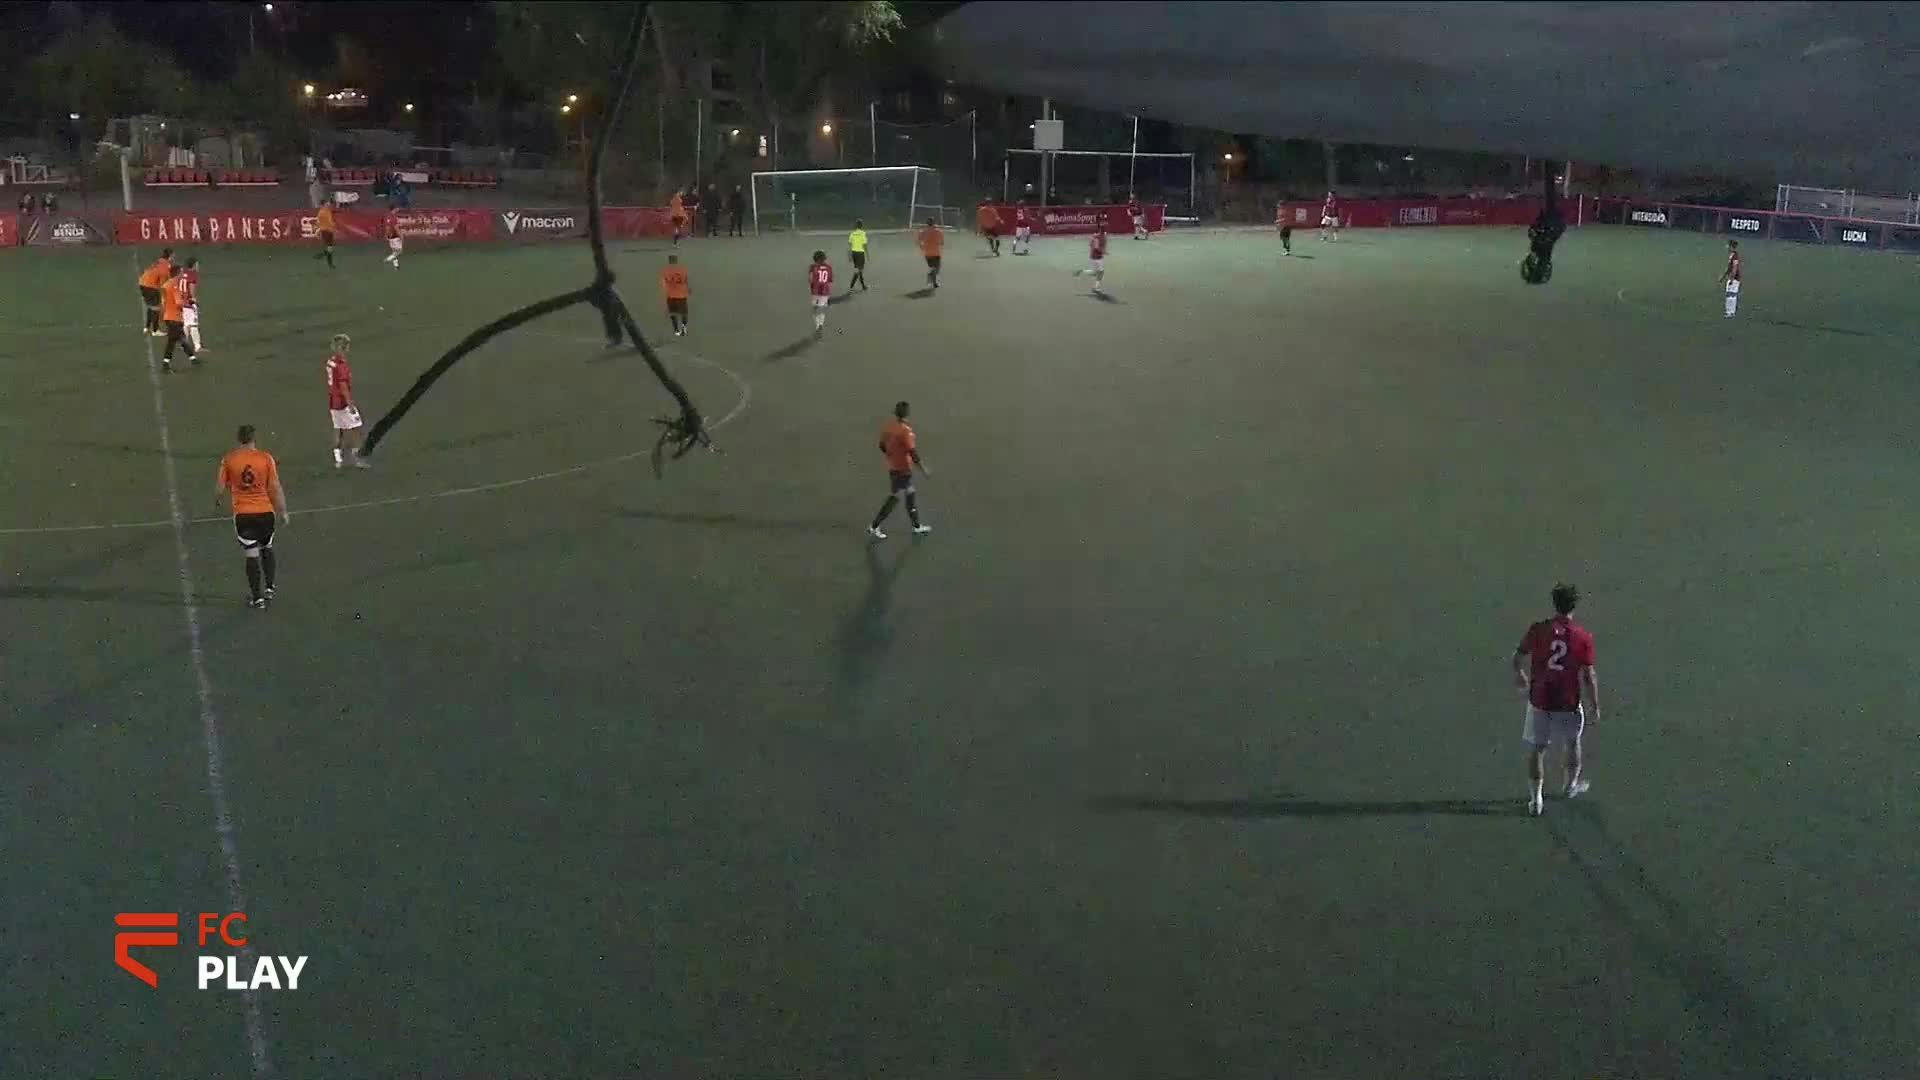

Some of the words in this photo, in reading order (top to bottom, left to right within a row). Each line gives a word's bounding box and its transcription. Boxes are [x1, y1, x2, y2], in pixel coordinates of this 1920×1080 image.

[522, 216, 575, 229] macron
[1731, 218, 1760, 232] RESPETO
[1843, 229, 1867, 243] LUCHA
[817, 270, 829, 283] 10
[241, 464, 254, 484] 6
[1547, 639, 1568, 671] 2
